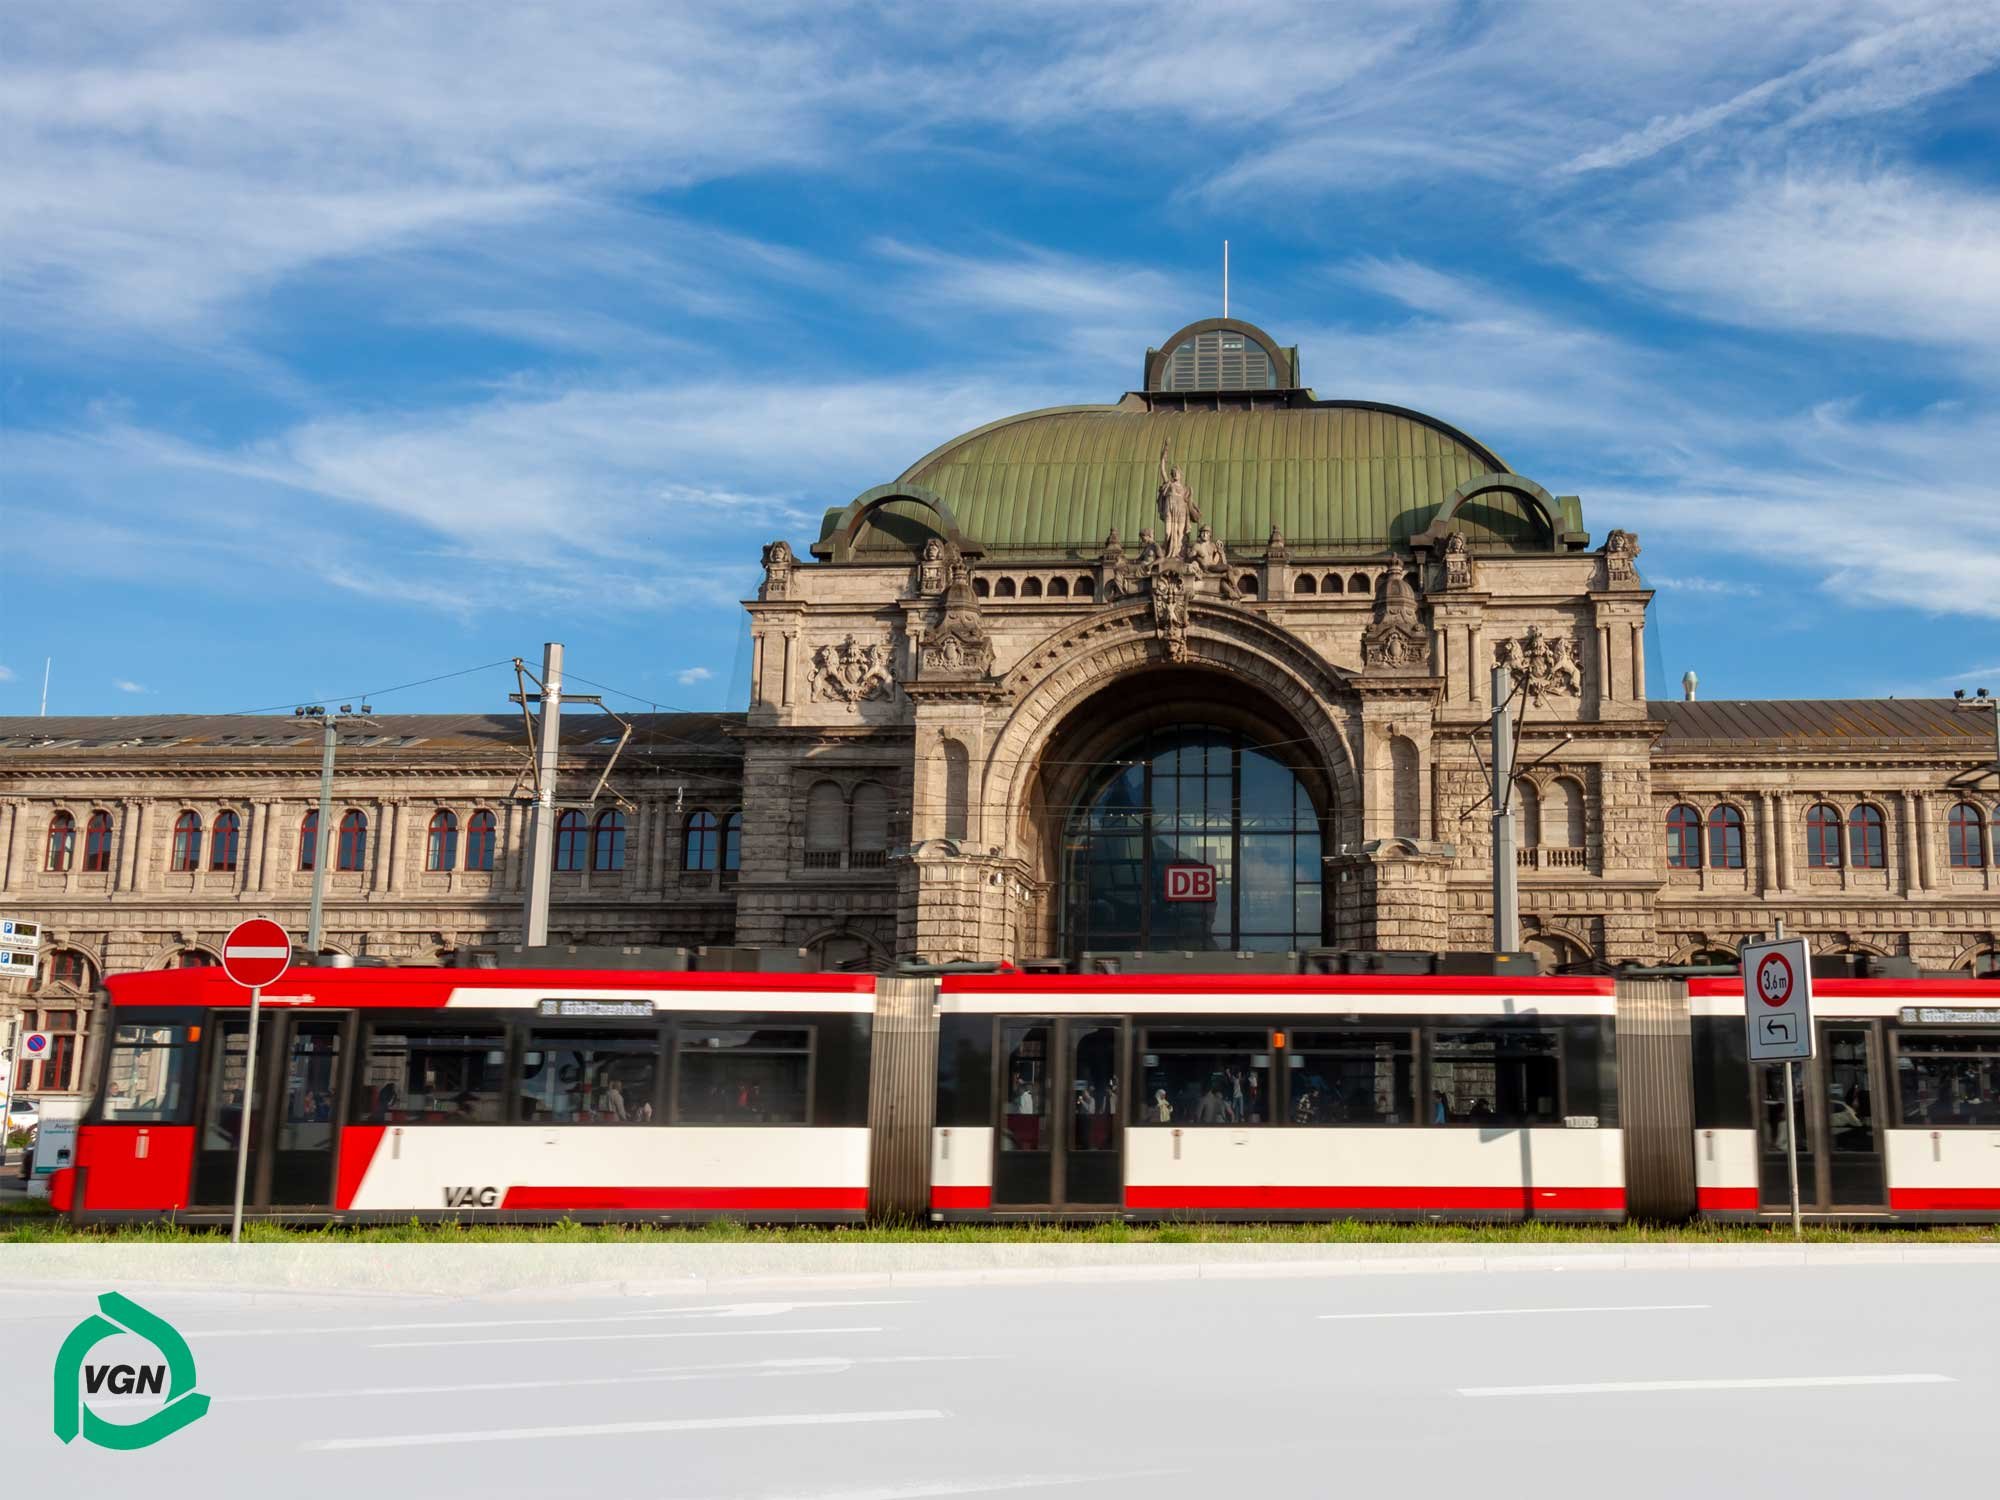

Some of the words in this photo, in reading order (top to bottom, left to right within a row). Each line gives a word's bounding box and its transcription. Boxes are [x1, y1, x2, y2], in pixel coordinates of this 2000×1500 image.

[1172, 871, 1211, 896] DB
[1779, 977, 1787, 988] m
[443, 1186, 498, 1208] VAG
